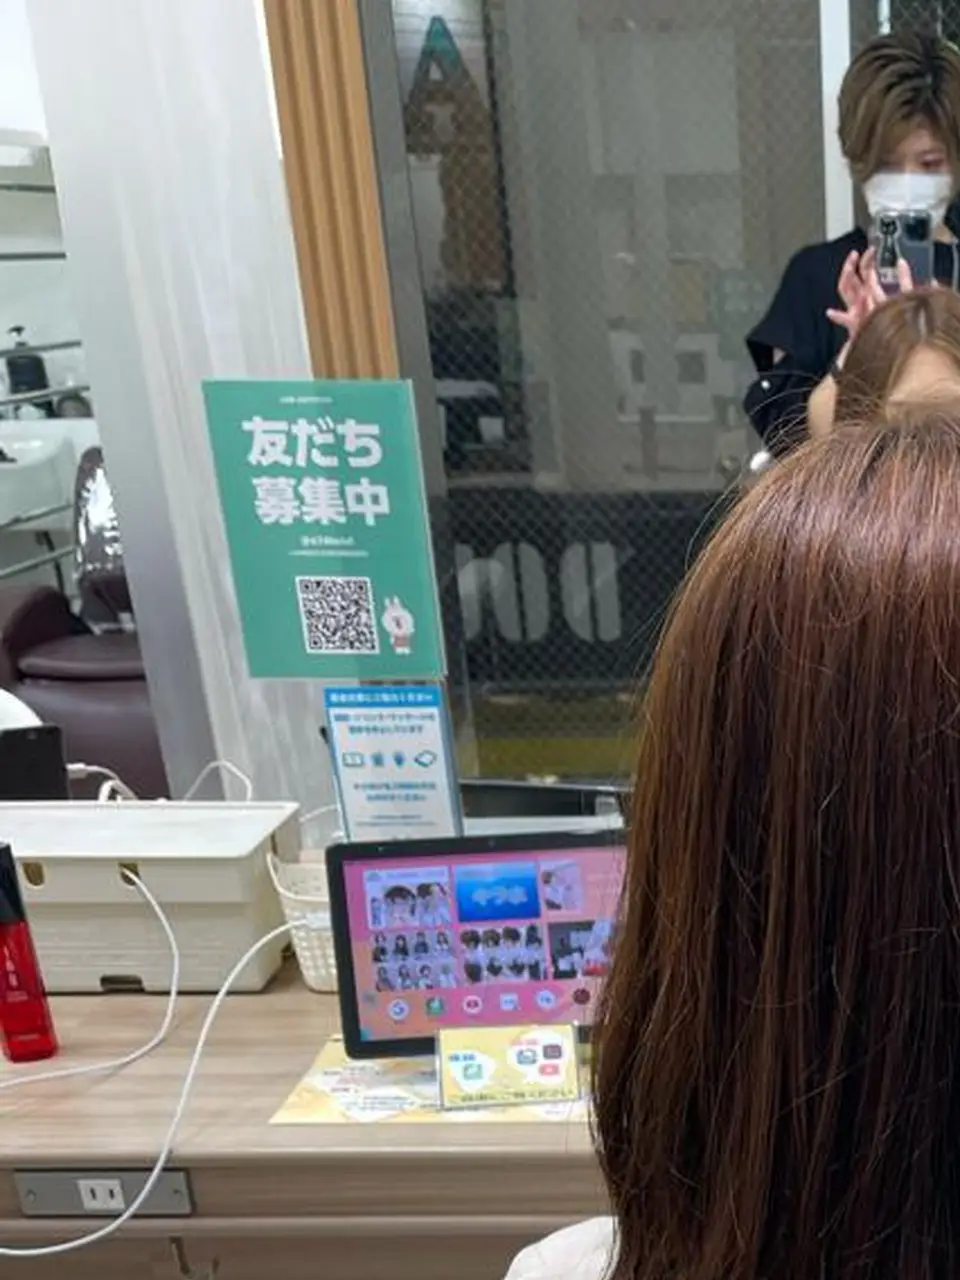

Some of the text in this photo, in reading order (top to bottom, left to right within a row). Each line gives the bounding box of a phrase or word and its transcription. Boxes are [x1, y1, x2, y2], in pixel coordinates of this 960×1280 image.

[241, 415, 383, 468] 友だち
[252, 476, 391, 526] 募集中
